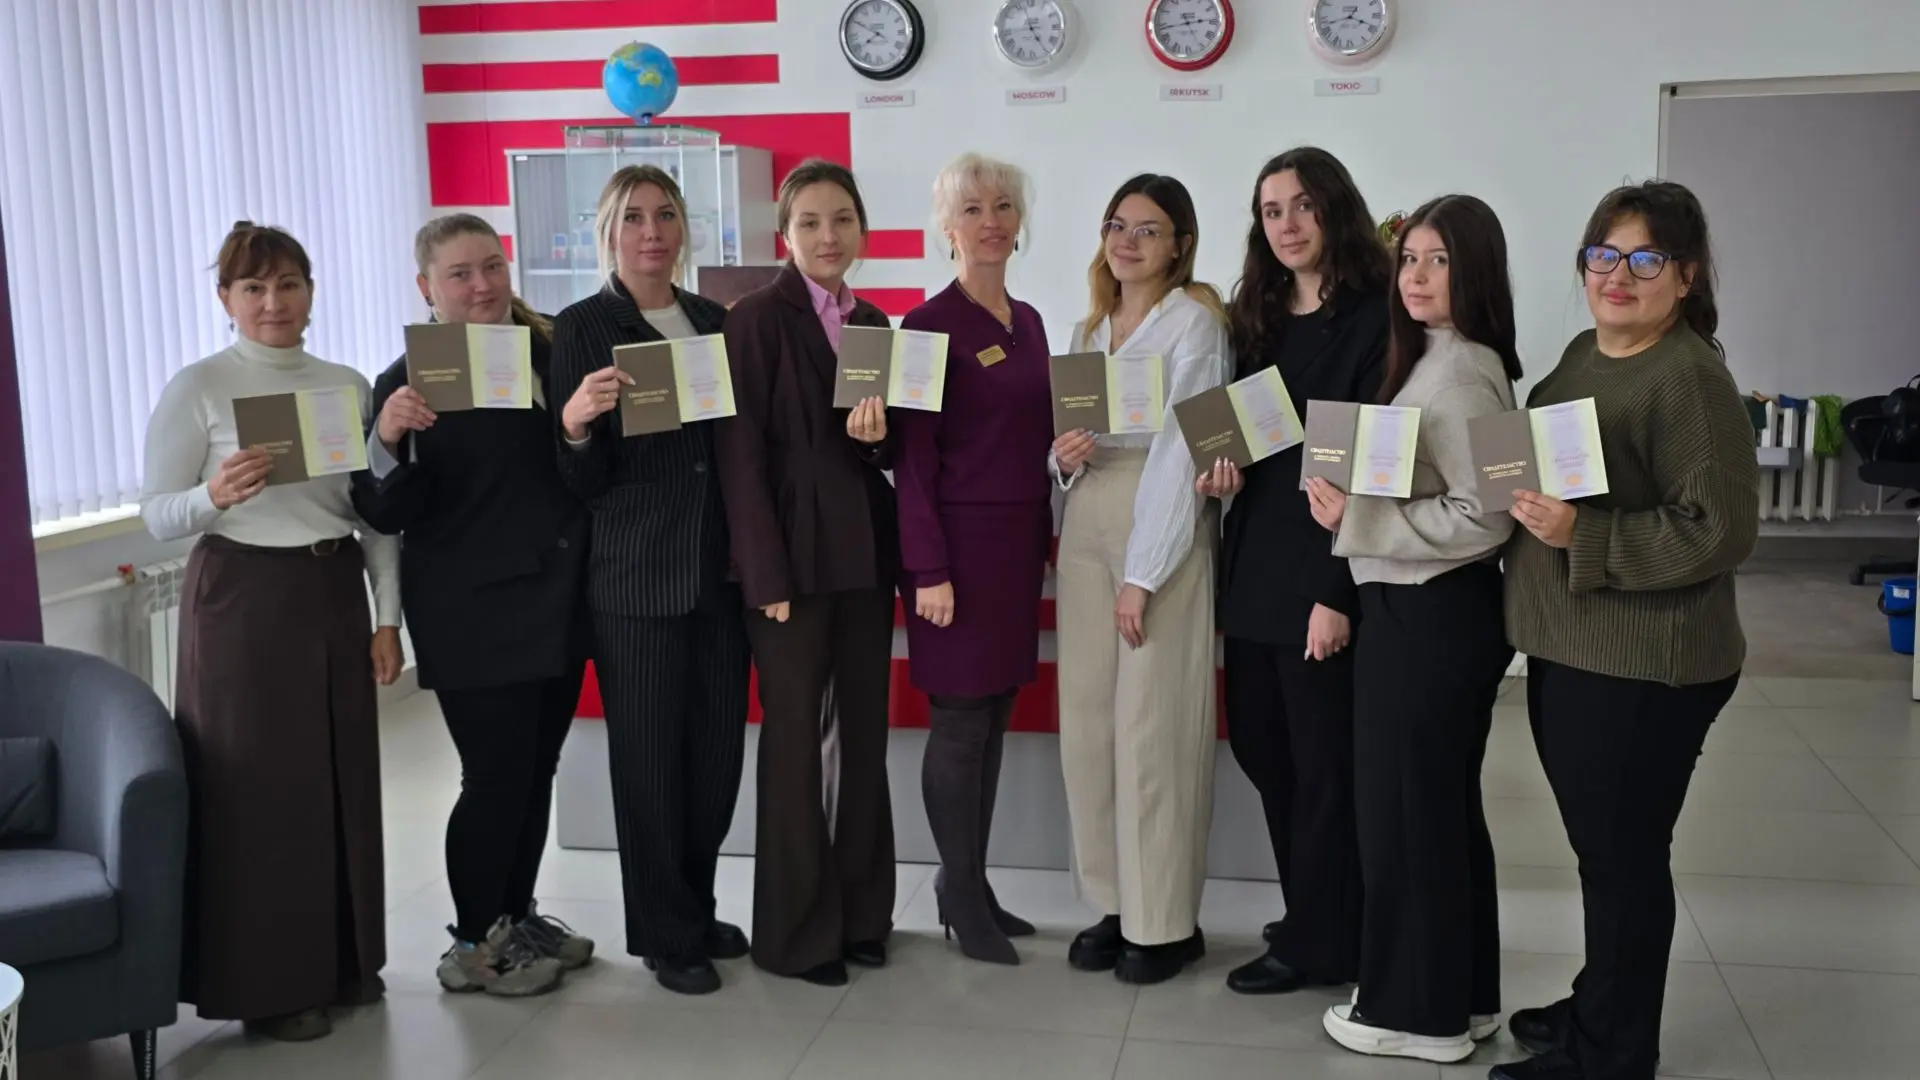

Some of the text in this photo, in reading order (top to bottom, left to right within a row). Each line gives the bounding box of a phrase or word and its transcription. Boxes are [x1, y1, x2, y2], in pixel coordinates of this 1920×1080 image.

[1330, 82, 1361, 91] TOKIO
[1012, 90, 1056, 100] MOSCOW
[1169, 87, 1210, 96] IRKUTSK
[864, 95, 904, 103] LONDON
